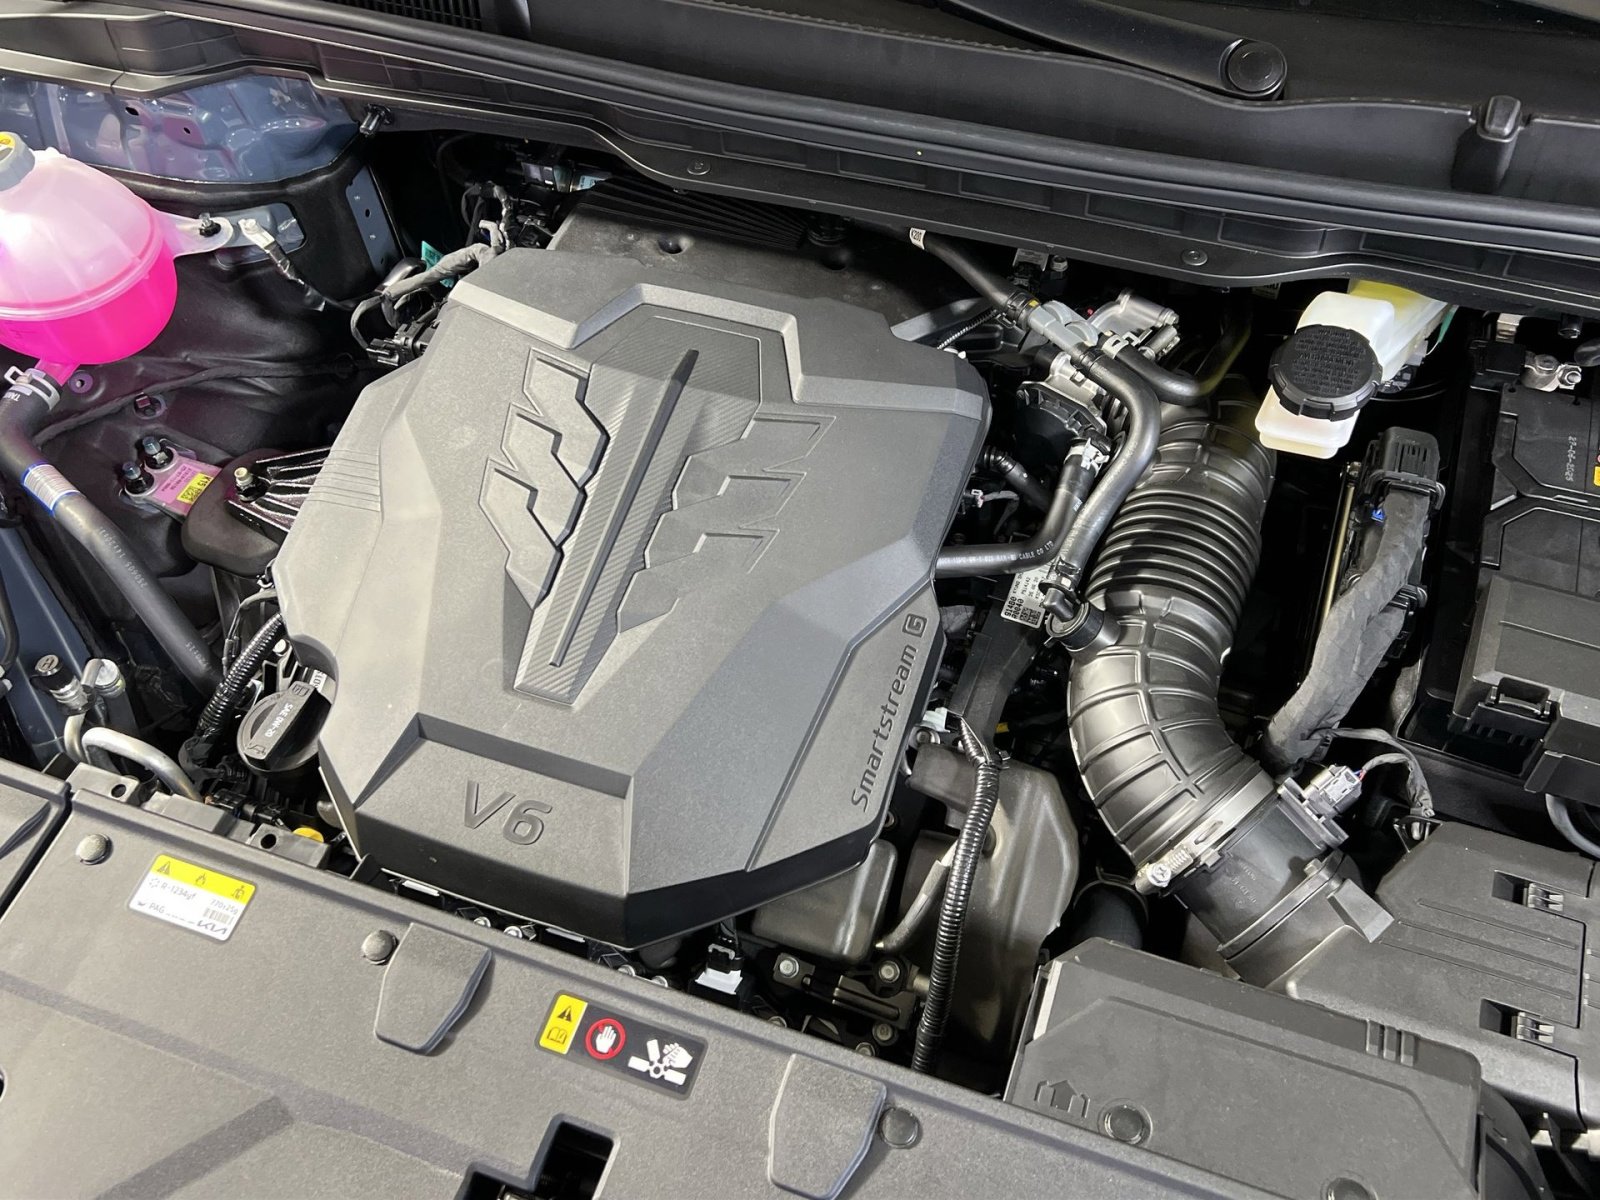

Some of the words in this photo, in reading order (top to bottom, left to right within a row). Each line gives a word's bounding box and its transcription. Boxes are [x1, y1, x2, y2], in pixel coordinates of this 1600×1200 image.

[1018, 551, 1035, 560] CABLE
[1036, 548, 1044, 556] CO
[1004, 596, 1017, 617] 91480
[278, 702, 293, 718] SAE
[264, 715, 285, 738] 0W-20
[851, 644, 917, 813] Smartstream
[464, 779, 553, 846] V6
[148, 901, 165, 914] PAG
